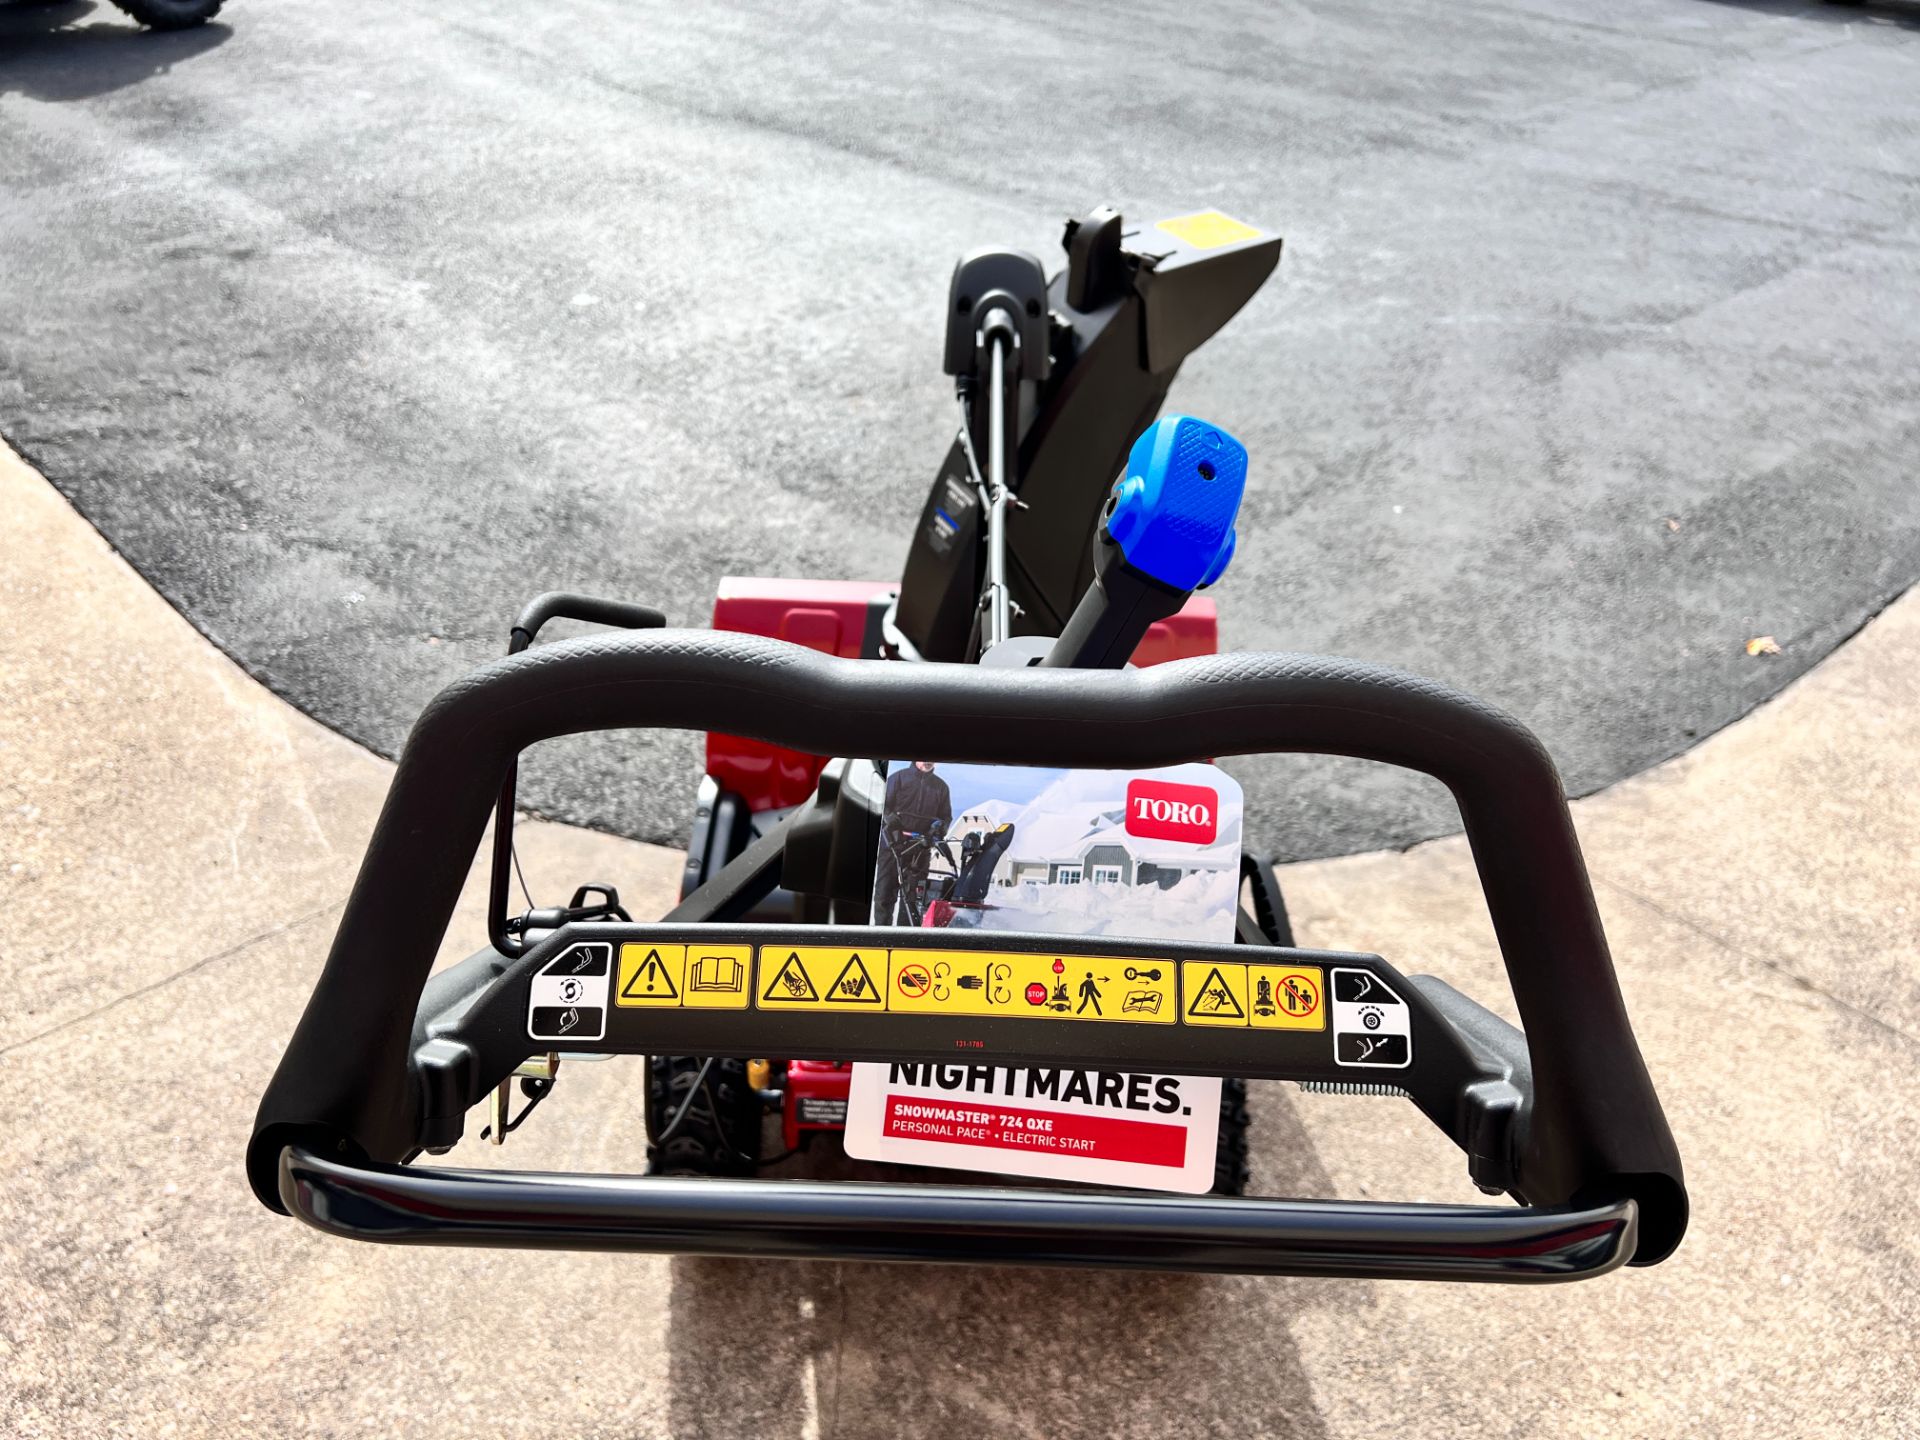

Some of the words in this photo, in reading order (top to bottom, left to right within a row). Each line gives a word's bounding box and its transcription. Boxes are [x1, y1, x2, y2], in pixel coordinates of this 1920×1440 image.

[1133, 797, 1210, 826] TORO
[1027, 990, 1045, 998] STOP
[889, 1063, 1192, 1116] NIGHTMARES.
[892, 1119, 953, 1136] PERSONAL
[1002, 1131, 1057, 1146] ELECTRIC
[1059, 1137, 1096, 1151] START
[999, 1115, 1024, 1128] 724
[1026, 1118, 1053, 1132] QXE
